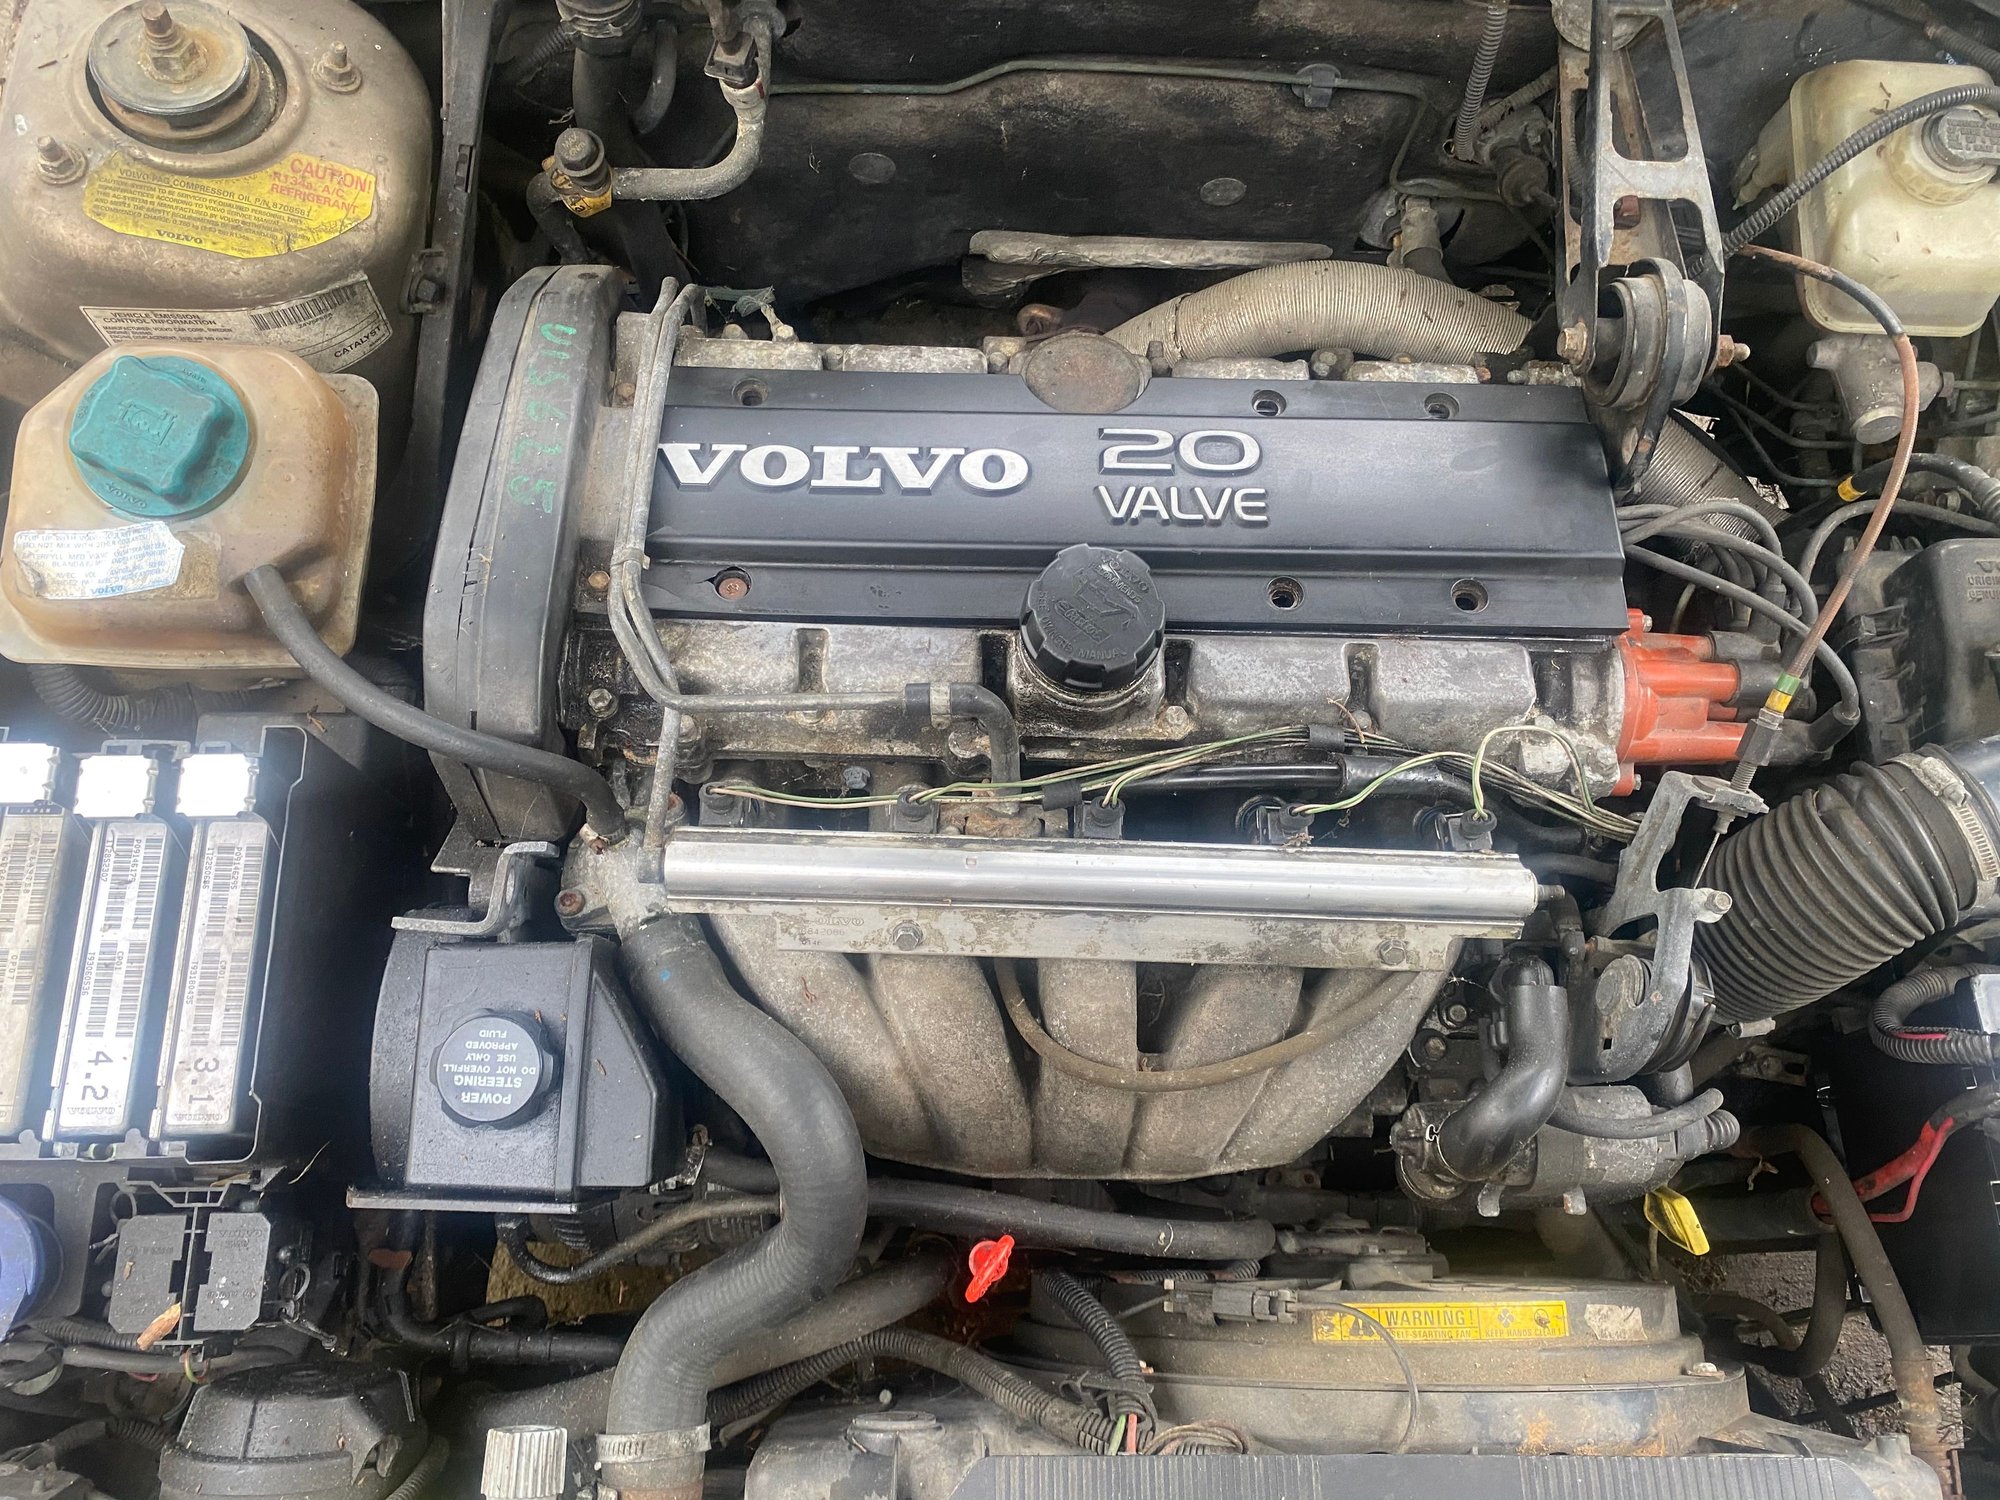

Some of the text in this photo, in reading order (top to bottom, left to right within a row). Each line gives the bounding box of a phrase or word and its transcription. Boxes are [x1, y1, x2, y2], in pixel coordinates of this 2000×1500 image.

[290, 158, 372, 194] CAUTION!
[173, 178, 235, 199] COMPRESSOR
[237, 193, 251, 203] OIL
[322, 184, 345, 199] A/C
[177, 192, 207, 203] SERVICED
[252, 209, 285, 221] PERSONNEL
[271, 183, 358, 215] REFRIGERANT
[156, 195, 192, 207] ACCORDING
[205, 205, 225, 214] VOLVO
[227, 210, 251, 220] SERVICE
[157, 202, 208, 216] MANUFACTURED
[156, 229, 203, 244] VOLVO
[150, 318, 217, 326] INFORMATION
[334, 325, 382, 357] CATALYST
[1099, 426, 1264, 476] 20
[658, 442, 1032, 493] VOLVO
[1096, 484, 1271, 525] VALVE
[479, 1029, 507, 1039] FLUID
[465, 1040, 519, 1050] APPROVED
[465, 1052, 517, 1062] USE ONLY
[81, 1051, 113, 1102] 4.2
[442, 1063, 537, 1075] DO NOT OVERFILL
[188, 1057, 220, 1105] 3.1
[454, 1075, 523, 1088] STEERING
[460, 1092, 512, 1104] POWER
[1392, 1329, 1472, 1339] SELF-STARTING FAN
[1485, 1328, 1504, 1338] KEEP
[1507, 1328, 1532, 1338] HANDS
